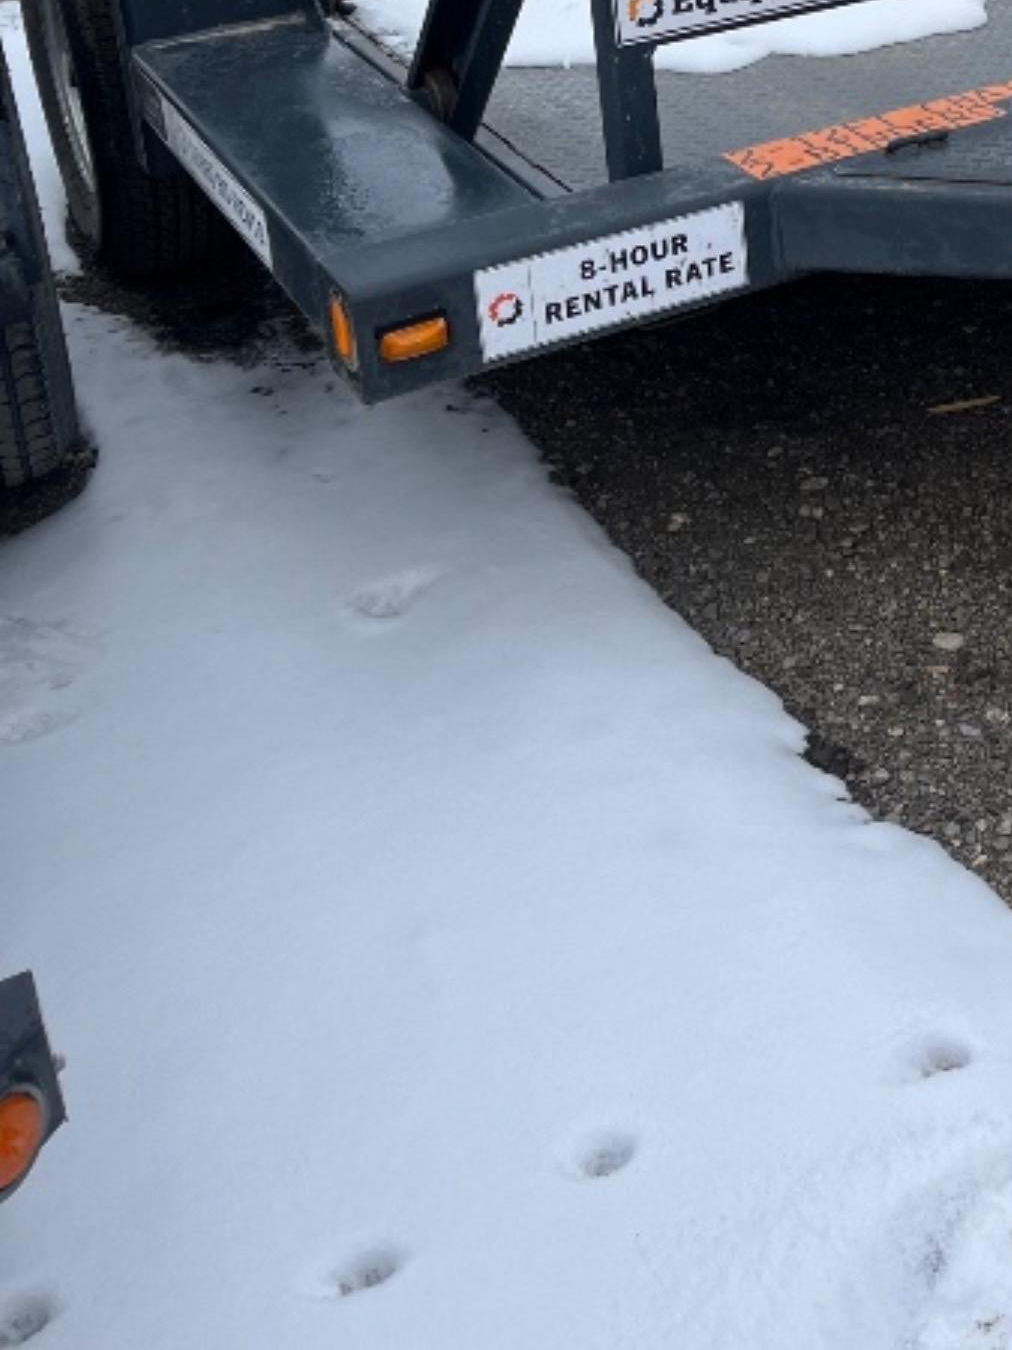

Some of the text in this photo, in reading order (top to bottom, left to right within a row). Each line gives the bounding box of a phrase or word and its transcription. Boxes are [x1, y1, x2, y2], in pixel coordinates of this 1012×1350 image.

[580, 233, 689, 281] 8-HOUR
[544, 251, 735, 325] RENTAL RATE
